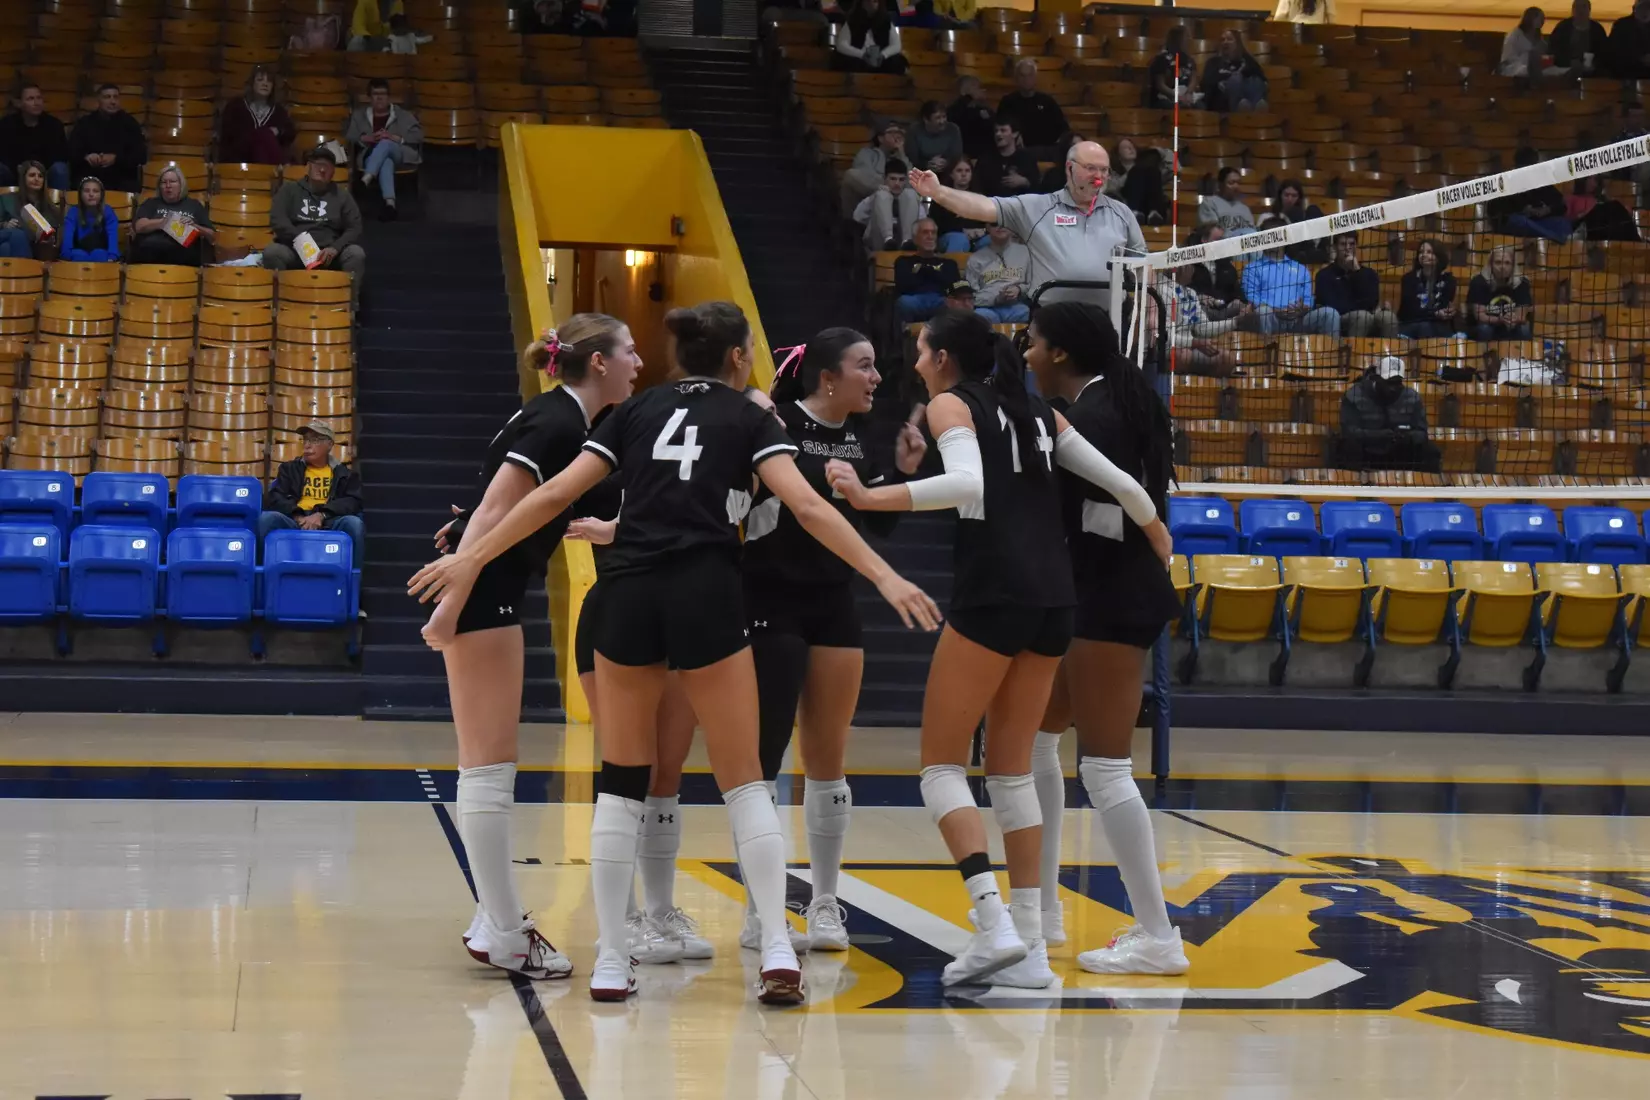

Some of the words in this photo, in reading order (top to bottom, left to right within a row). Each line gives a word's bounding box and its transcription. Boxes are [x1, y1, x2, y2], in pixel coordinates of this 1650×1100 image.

[1574, 152, 1598, 172] RACER
[1442, 187, 1460, 204] RACER
[1333, 214, 1349, 228] RACER
[652, 408, 703, 481] 4
[305, 477, 331, 487] ACE
[305, 488, 329, 498] ATIO
